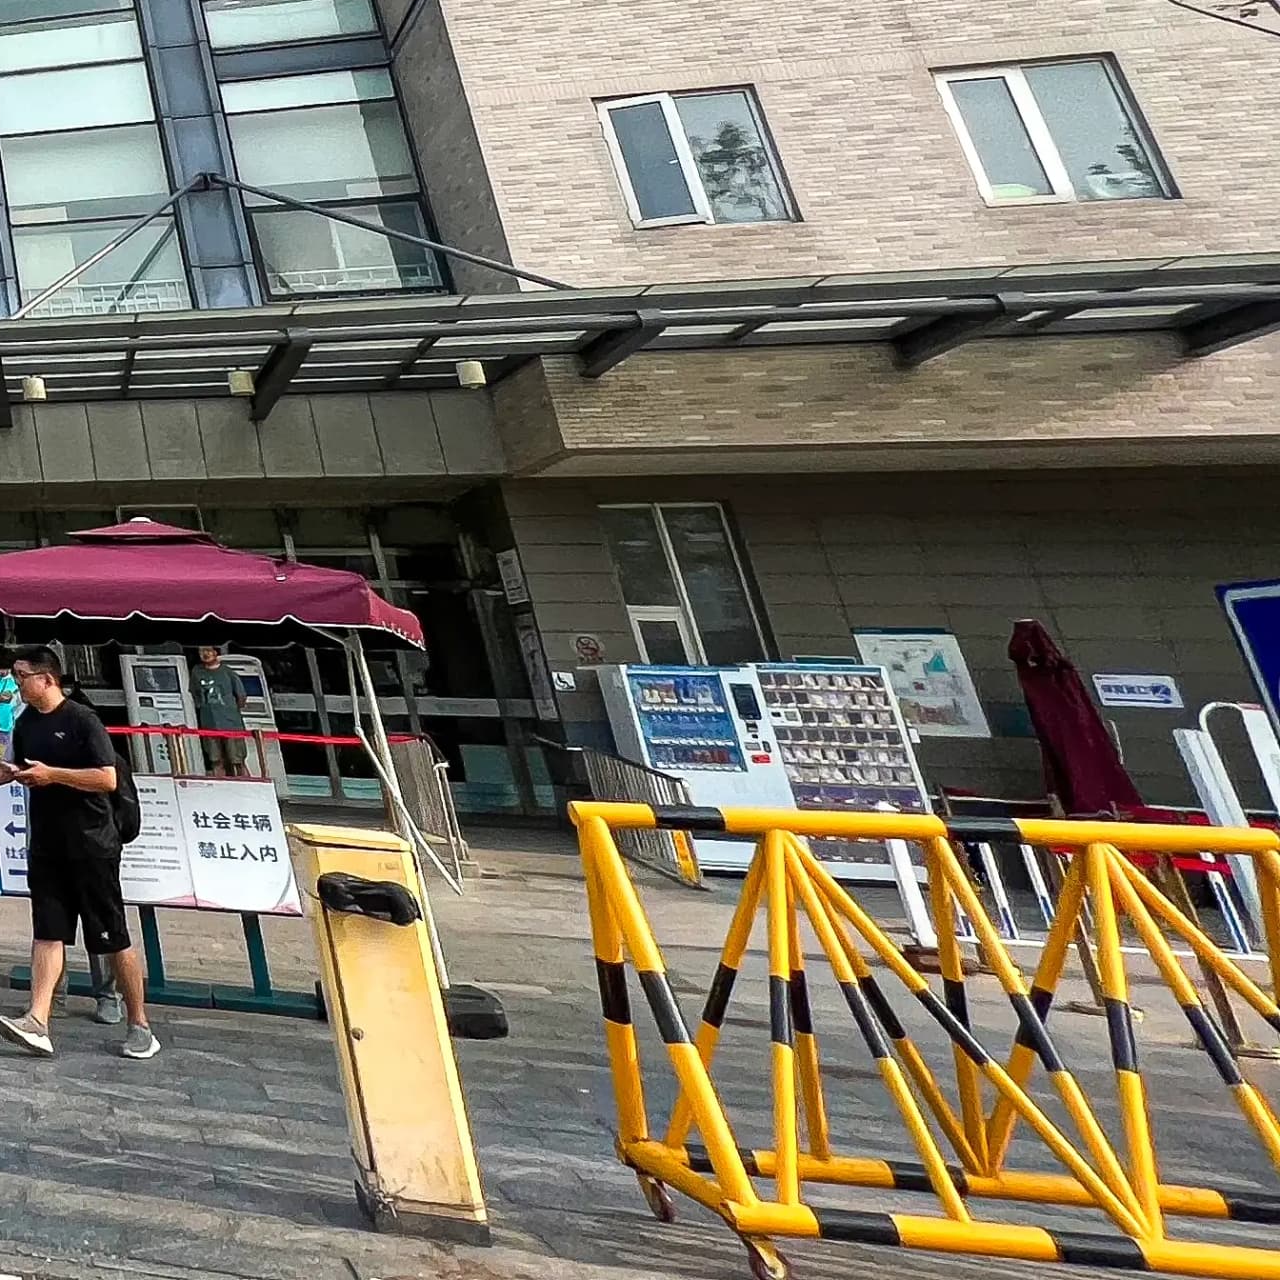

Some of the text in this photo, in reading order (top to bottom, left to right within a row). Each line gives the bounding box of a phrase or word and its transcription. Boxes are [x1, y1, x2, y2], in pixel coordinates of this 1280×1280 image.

[192, 811, 272, 832] 社会车辆
[198, 841, 278, 863] 禁止入内
